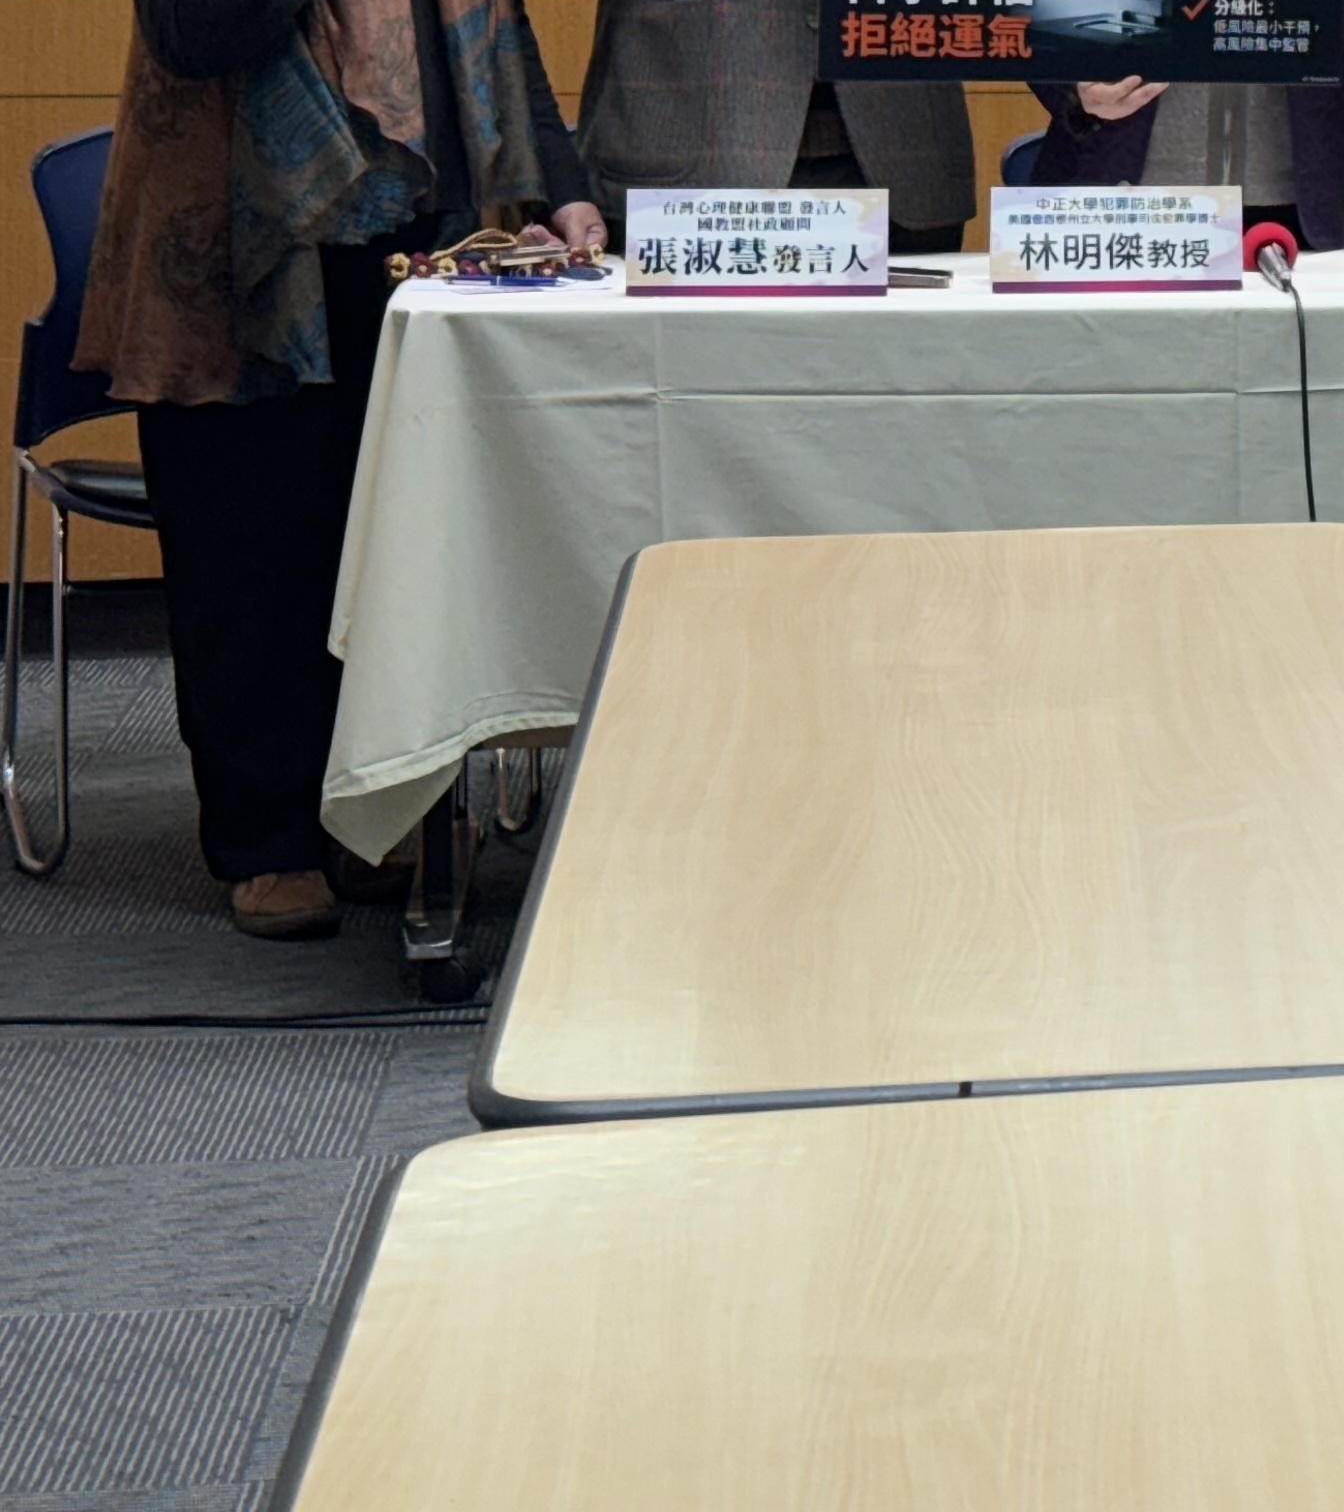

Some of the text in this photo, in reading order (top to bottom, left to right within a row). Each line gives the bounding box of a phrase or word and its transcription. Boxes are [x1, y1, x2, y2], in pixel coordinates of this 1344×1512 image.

[841, 13, 1033, 60] 拒絕運氣
[639, 237, 870, 275] 張淑慧發言人
[1020, 232, 1210, 271] 林明傑教授
